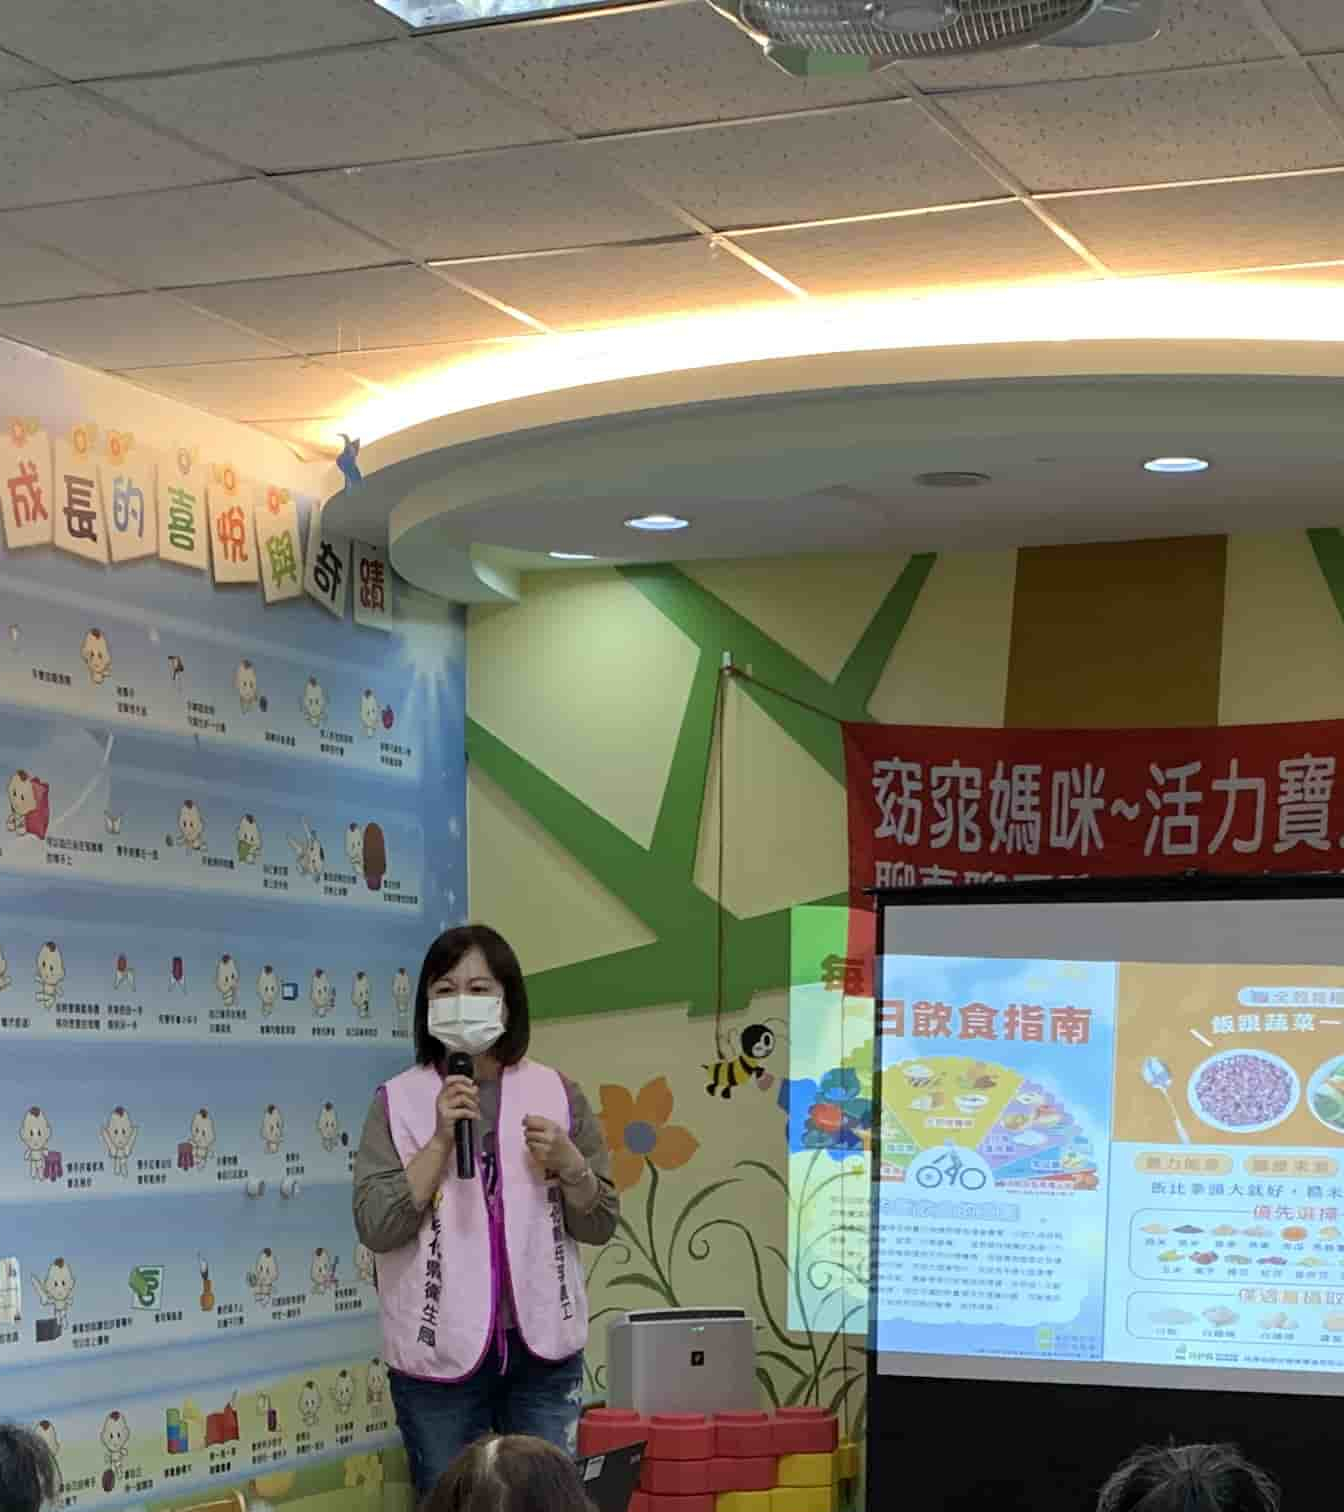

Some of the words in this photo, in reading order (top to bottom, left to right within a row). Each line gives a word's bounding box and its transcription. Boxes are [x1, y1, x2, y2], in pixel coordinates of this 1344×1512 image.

[880, 1000, 1091, 1044] 日飲食指南
